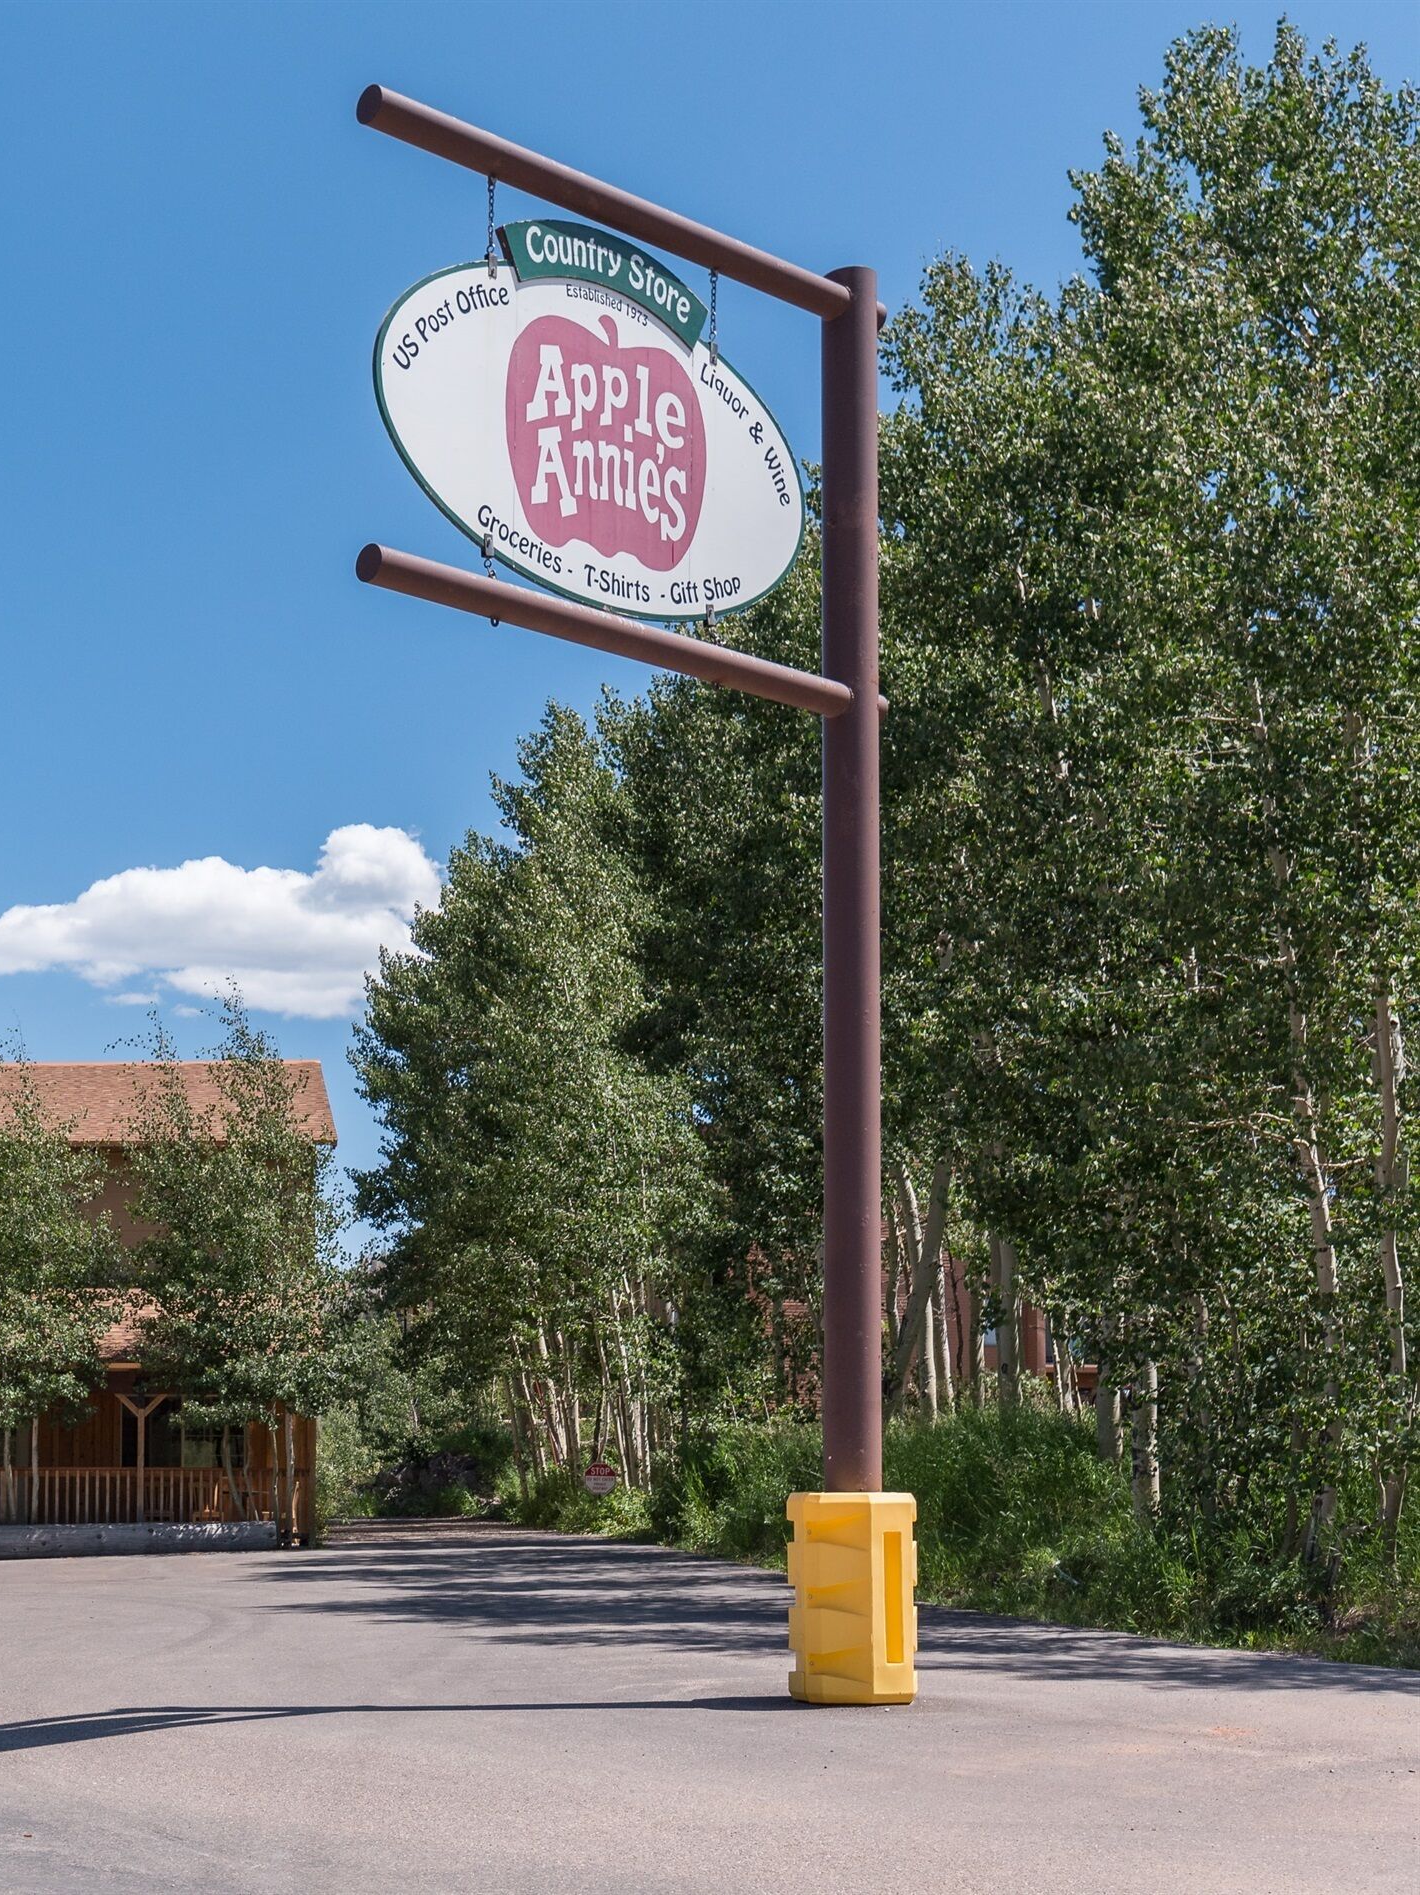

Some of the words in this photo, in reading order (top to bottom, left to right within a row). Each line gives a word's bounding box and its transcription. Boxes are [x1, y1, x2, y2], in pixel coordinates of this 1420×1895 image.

[525, 225, 622, 278] Country
[628, 253, 691, 324] Store
[566, 284, 623, 312] Established
[625, 303, 649, 327] 1973
[392, 333, 420, 370] US
[414, 299, 455, 343] Post
[456, 284, 510, 315] Office
[526, 344, 686, 449] Apple
[700, 363, 750, 420] Liquor
[749, 421, 764, 445] &
[764, 446, 791, 507] Wine
[531, 424, 687, 542] Annie's
[477, 504, 562, 574] Groceries
[584, 563, 650, 603] T-Shirts
[670, 581, 699, 605] Gift
[703, 576, 741, 602] Shop
[590, 1467, 610, 1475] STOP
